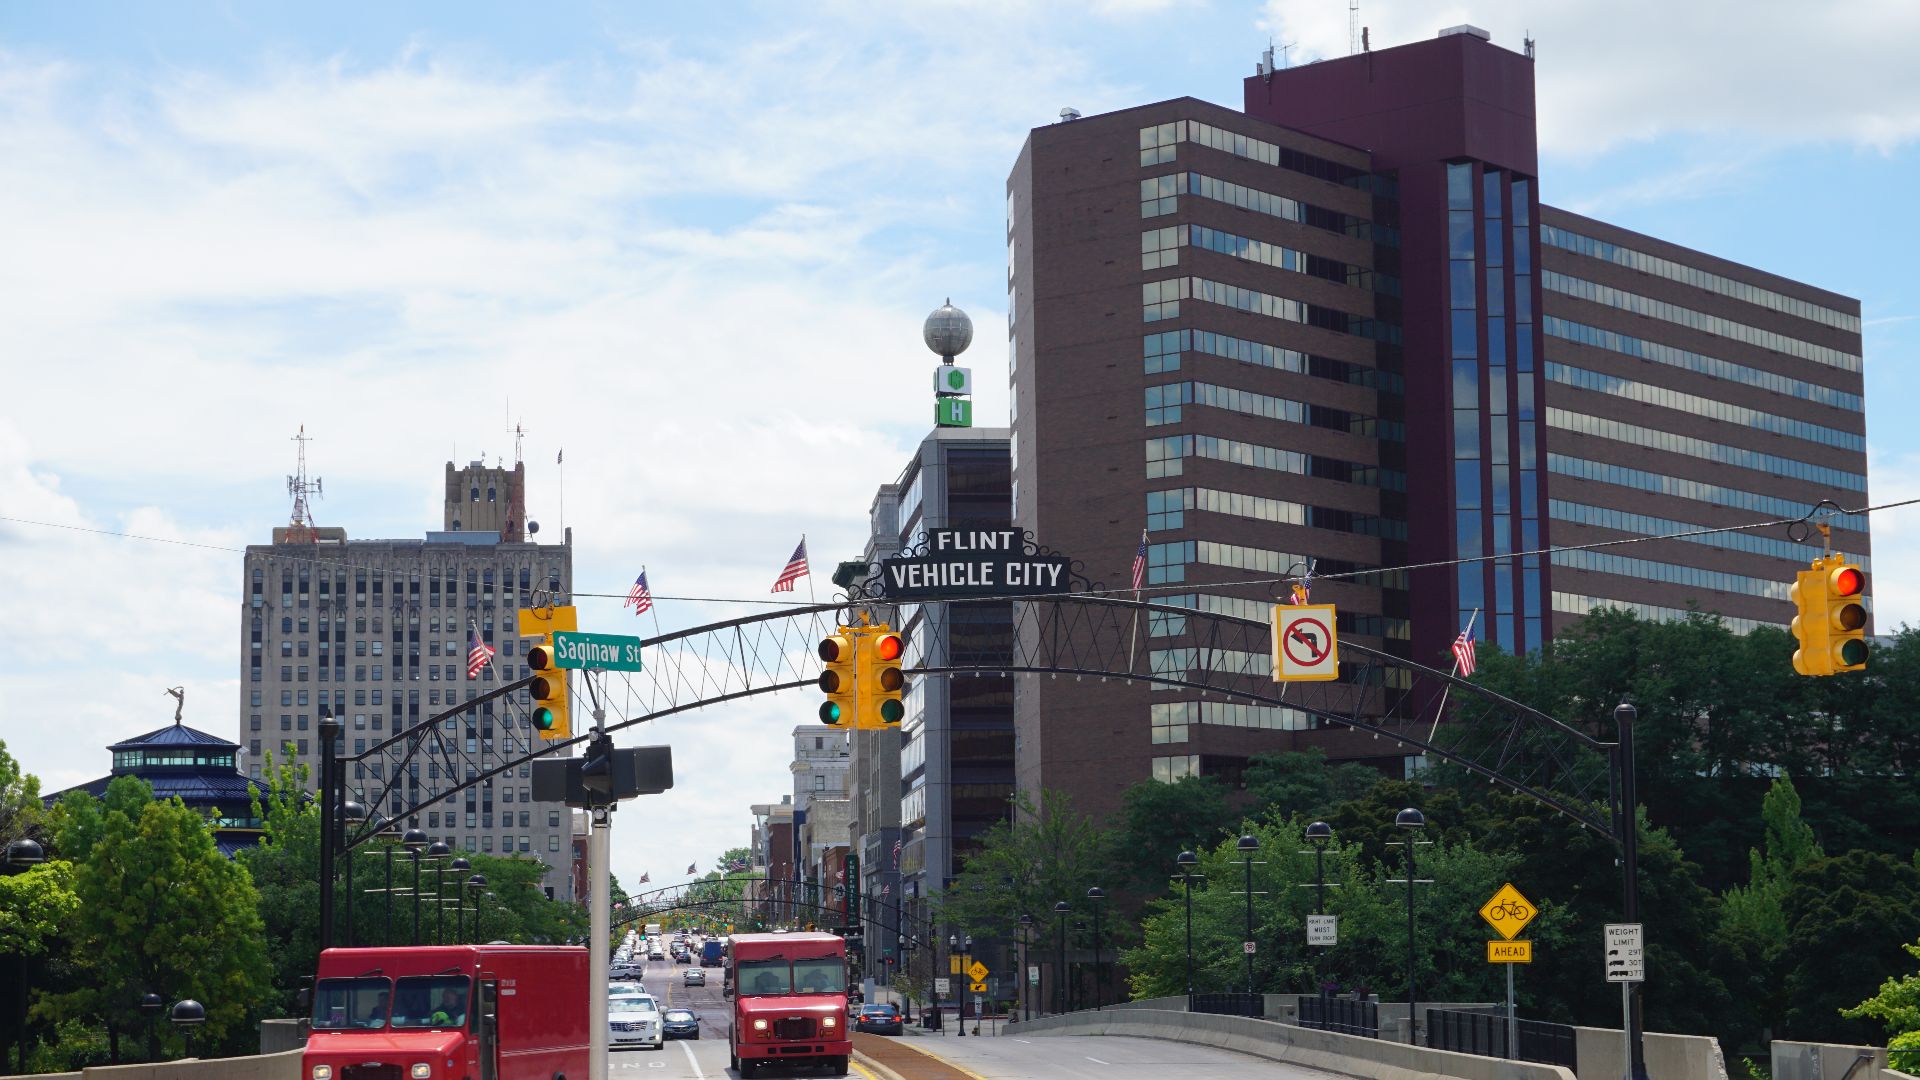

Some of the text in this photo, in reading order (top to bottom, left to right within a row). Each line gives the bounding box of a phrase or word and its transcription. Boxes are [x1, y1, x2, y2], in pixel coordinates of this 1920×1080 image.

[951, 401, 963, 421] H
[937, 531, 1015, 550] FLINT
[891, 562, 1063, 588] VEHICLE CITY
[558, 635, 640, 668] Saginaw St
[1608, 928, 1639, 936] WEIGHT
[1494, 946, 1526, 957] AHEAD
[1613, 938, 1635, 946] LIMIT
